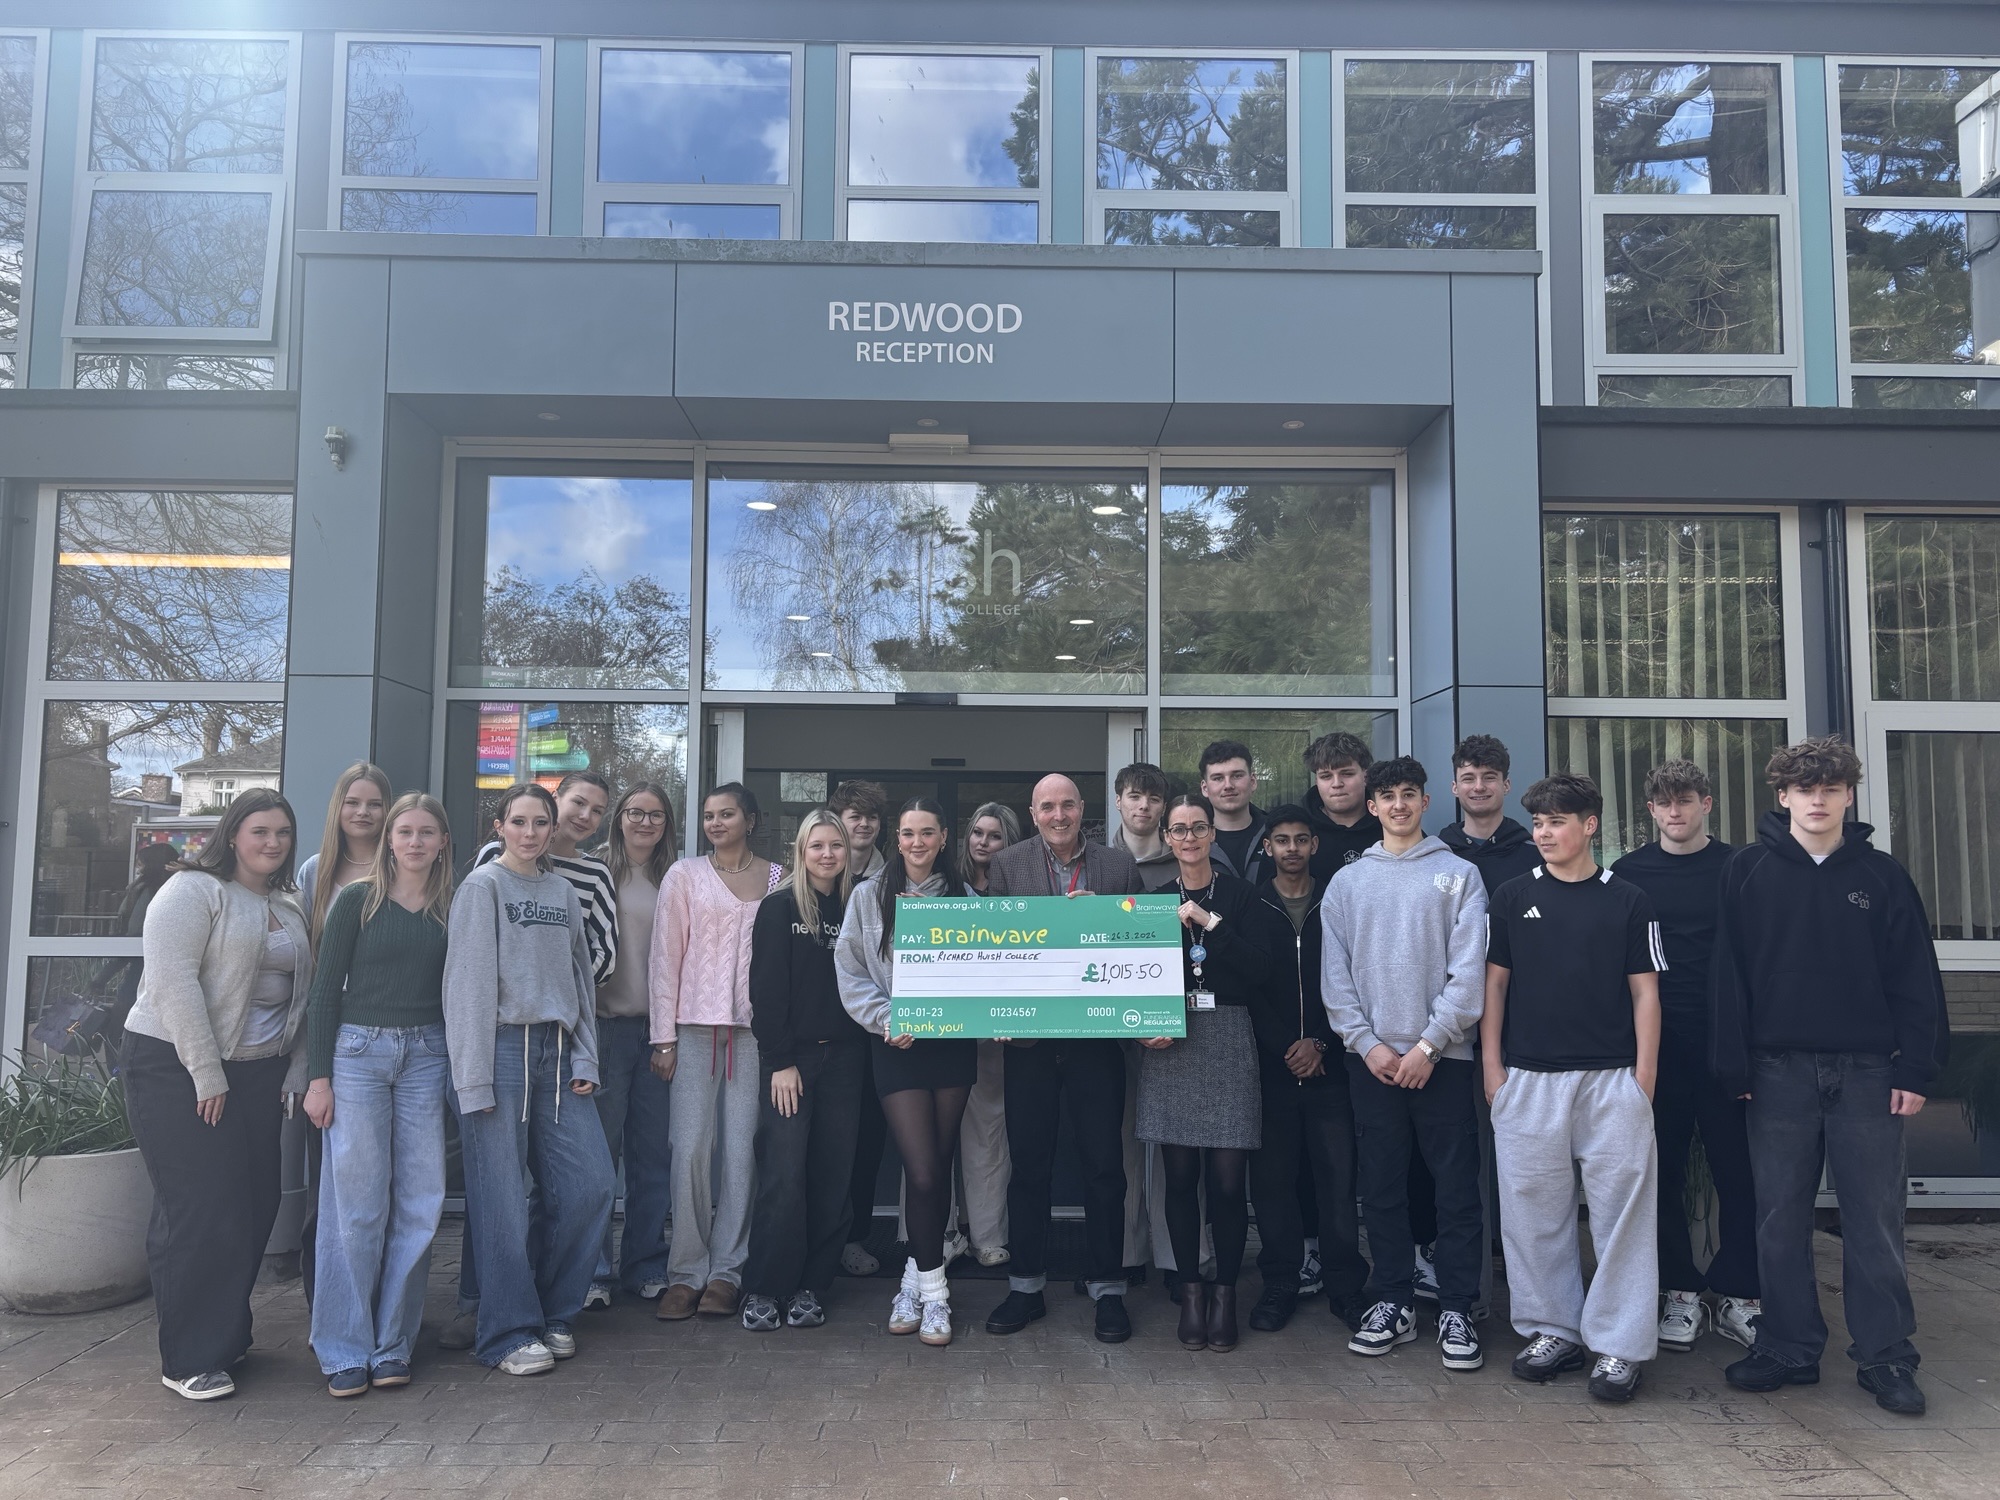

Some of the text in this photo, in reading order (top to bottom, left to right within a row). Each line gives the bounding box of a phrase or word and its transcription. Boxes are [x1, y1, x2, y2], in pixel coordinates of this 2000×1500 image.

[828, 301, 1023, 333] REDWOOD
[856, 341, 994, 364] RECEPTION
[957, 604, 1021, 616] COLLEGE
[902, 901, 982, 911] brainwave.org.uk
[518, 900, 569, 925] Elemen
[901, 934, 926, 944] PAY:
[929, 923, 1048, 945] Brainwave
[1080, 933, 1110, 943] DATE:
[900, 953, 935, 963] FROM:
[937, 950, 973, 962] RICHARD
[897, 1007, 943, 1017] 00-01-23
[990, 1007, 1037, 1017] 01234567
[1087, 1007, 1116, 1017] 00001
[1126, 1014, 1138, 1023] FR
[898, 1021, 964, 1036] Thank you!
